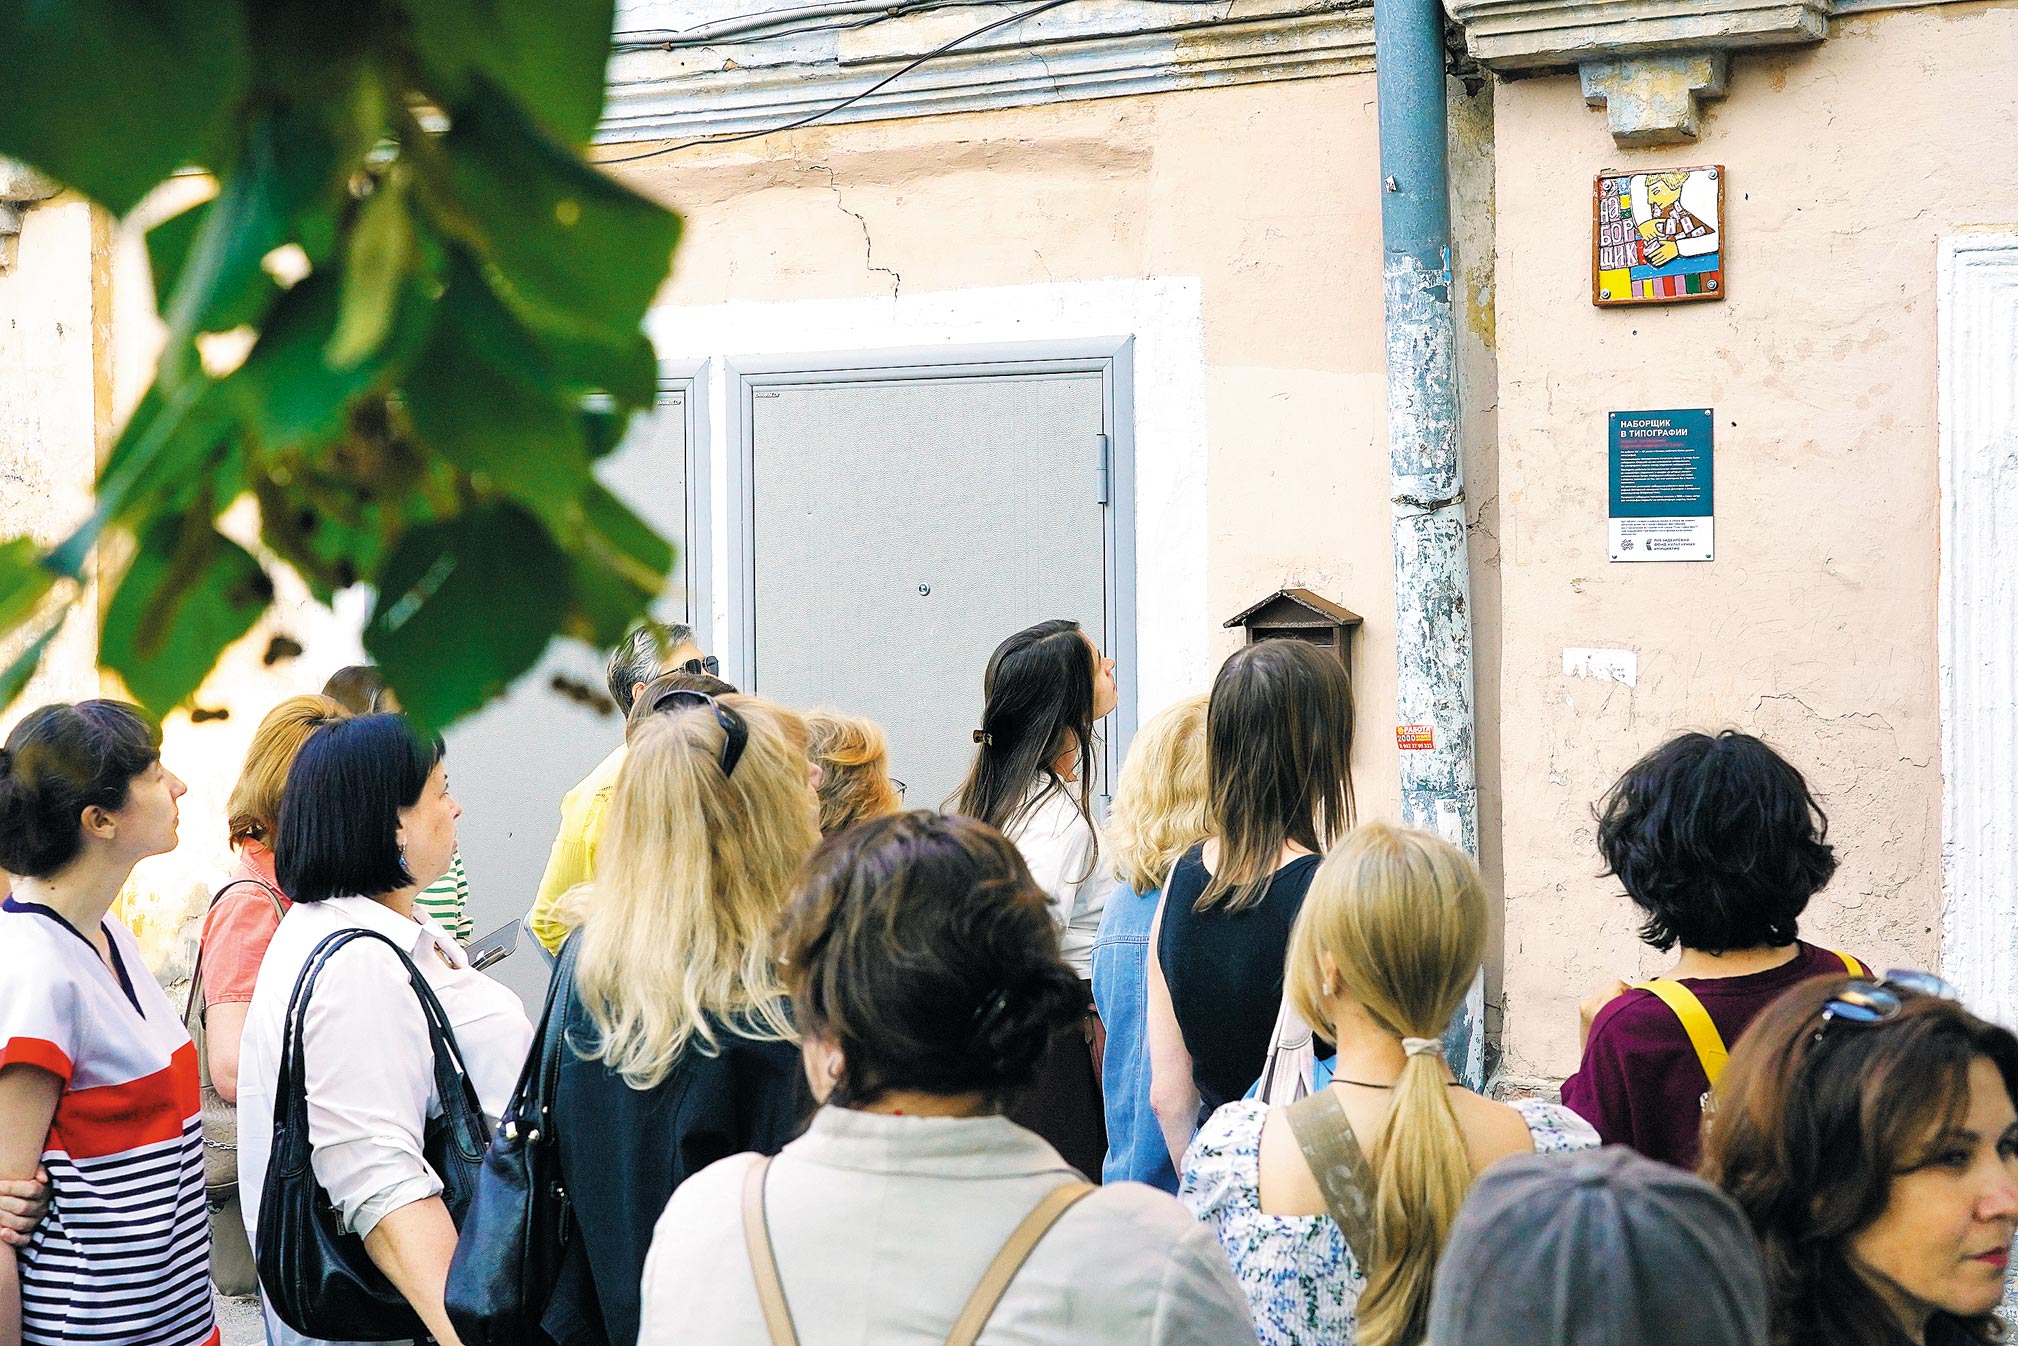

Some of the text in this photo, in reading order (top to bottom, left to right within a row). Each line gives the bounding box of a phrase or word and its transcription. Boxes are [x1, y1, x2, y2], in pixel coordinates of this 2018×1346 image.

[1600, 219, 1634, 246] БОР
[1600, 243, 1638, 268] ЩИК
[1620, 419, 1671, 428] НАБОРЩИК
[1629, 428, 1688, 437] ТИПОГРАФИИ
[1397, 734, 1416, 742] 2000
